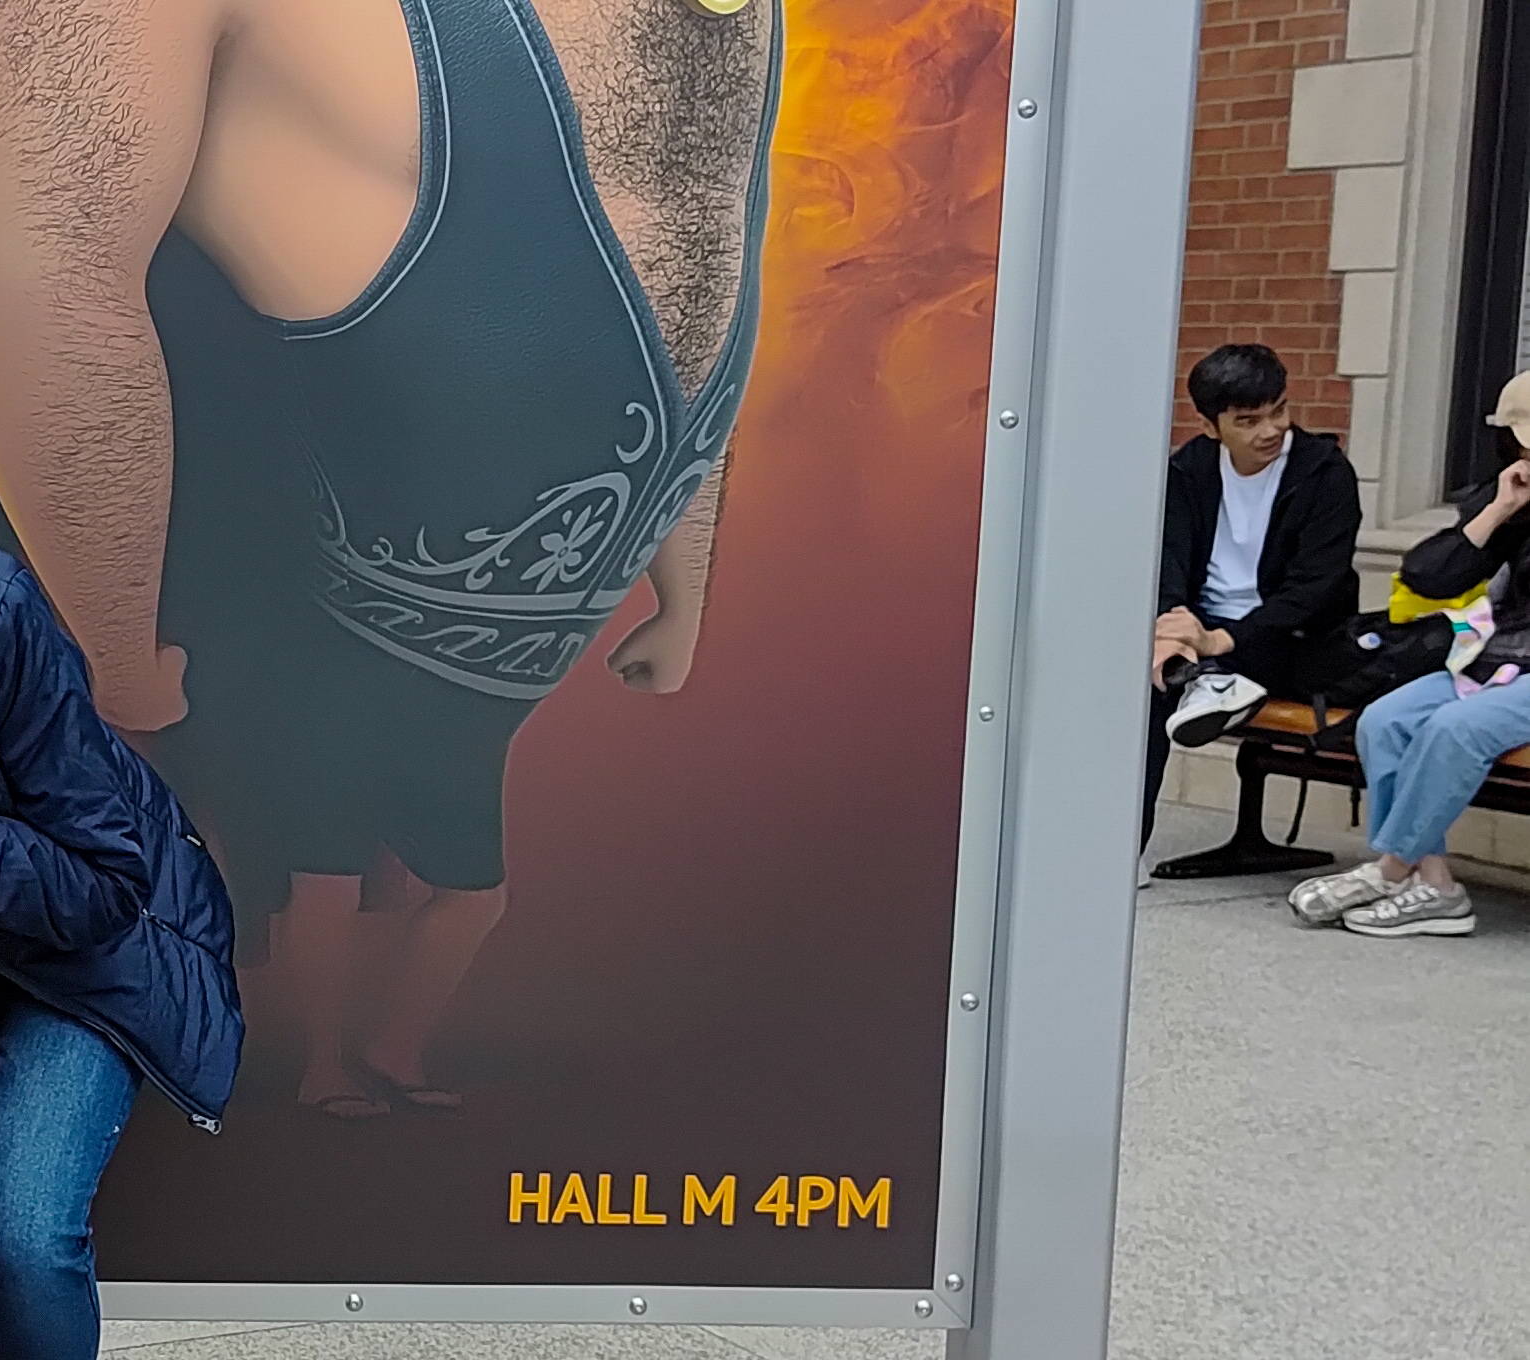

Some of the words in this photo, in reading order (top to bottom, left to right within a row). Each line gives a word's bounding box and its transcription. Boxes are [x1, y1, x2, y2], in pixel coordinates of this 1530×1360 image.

[508, 1172, 667, 1225] HALL
[682, 1174, 736, 1226] M
[754, 1175, 892, 1229] 4PM
